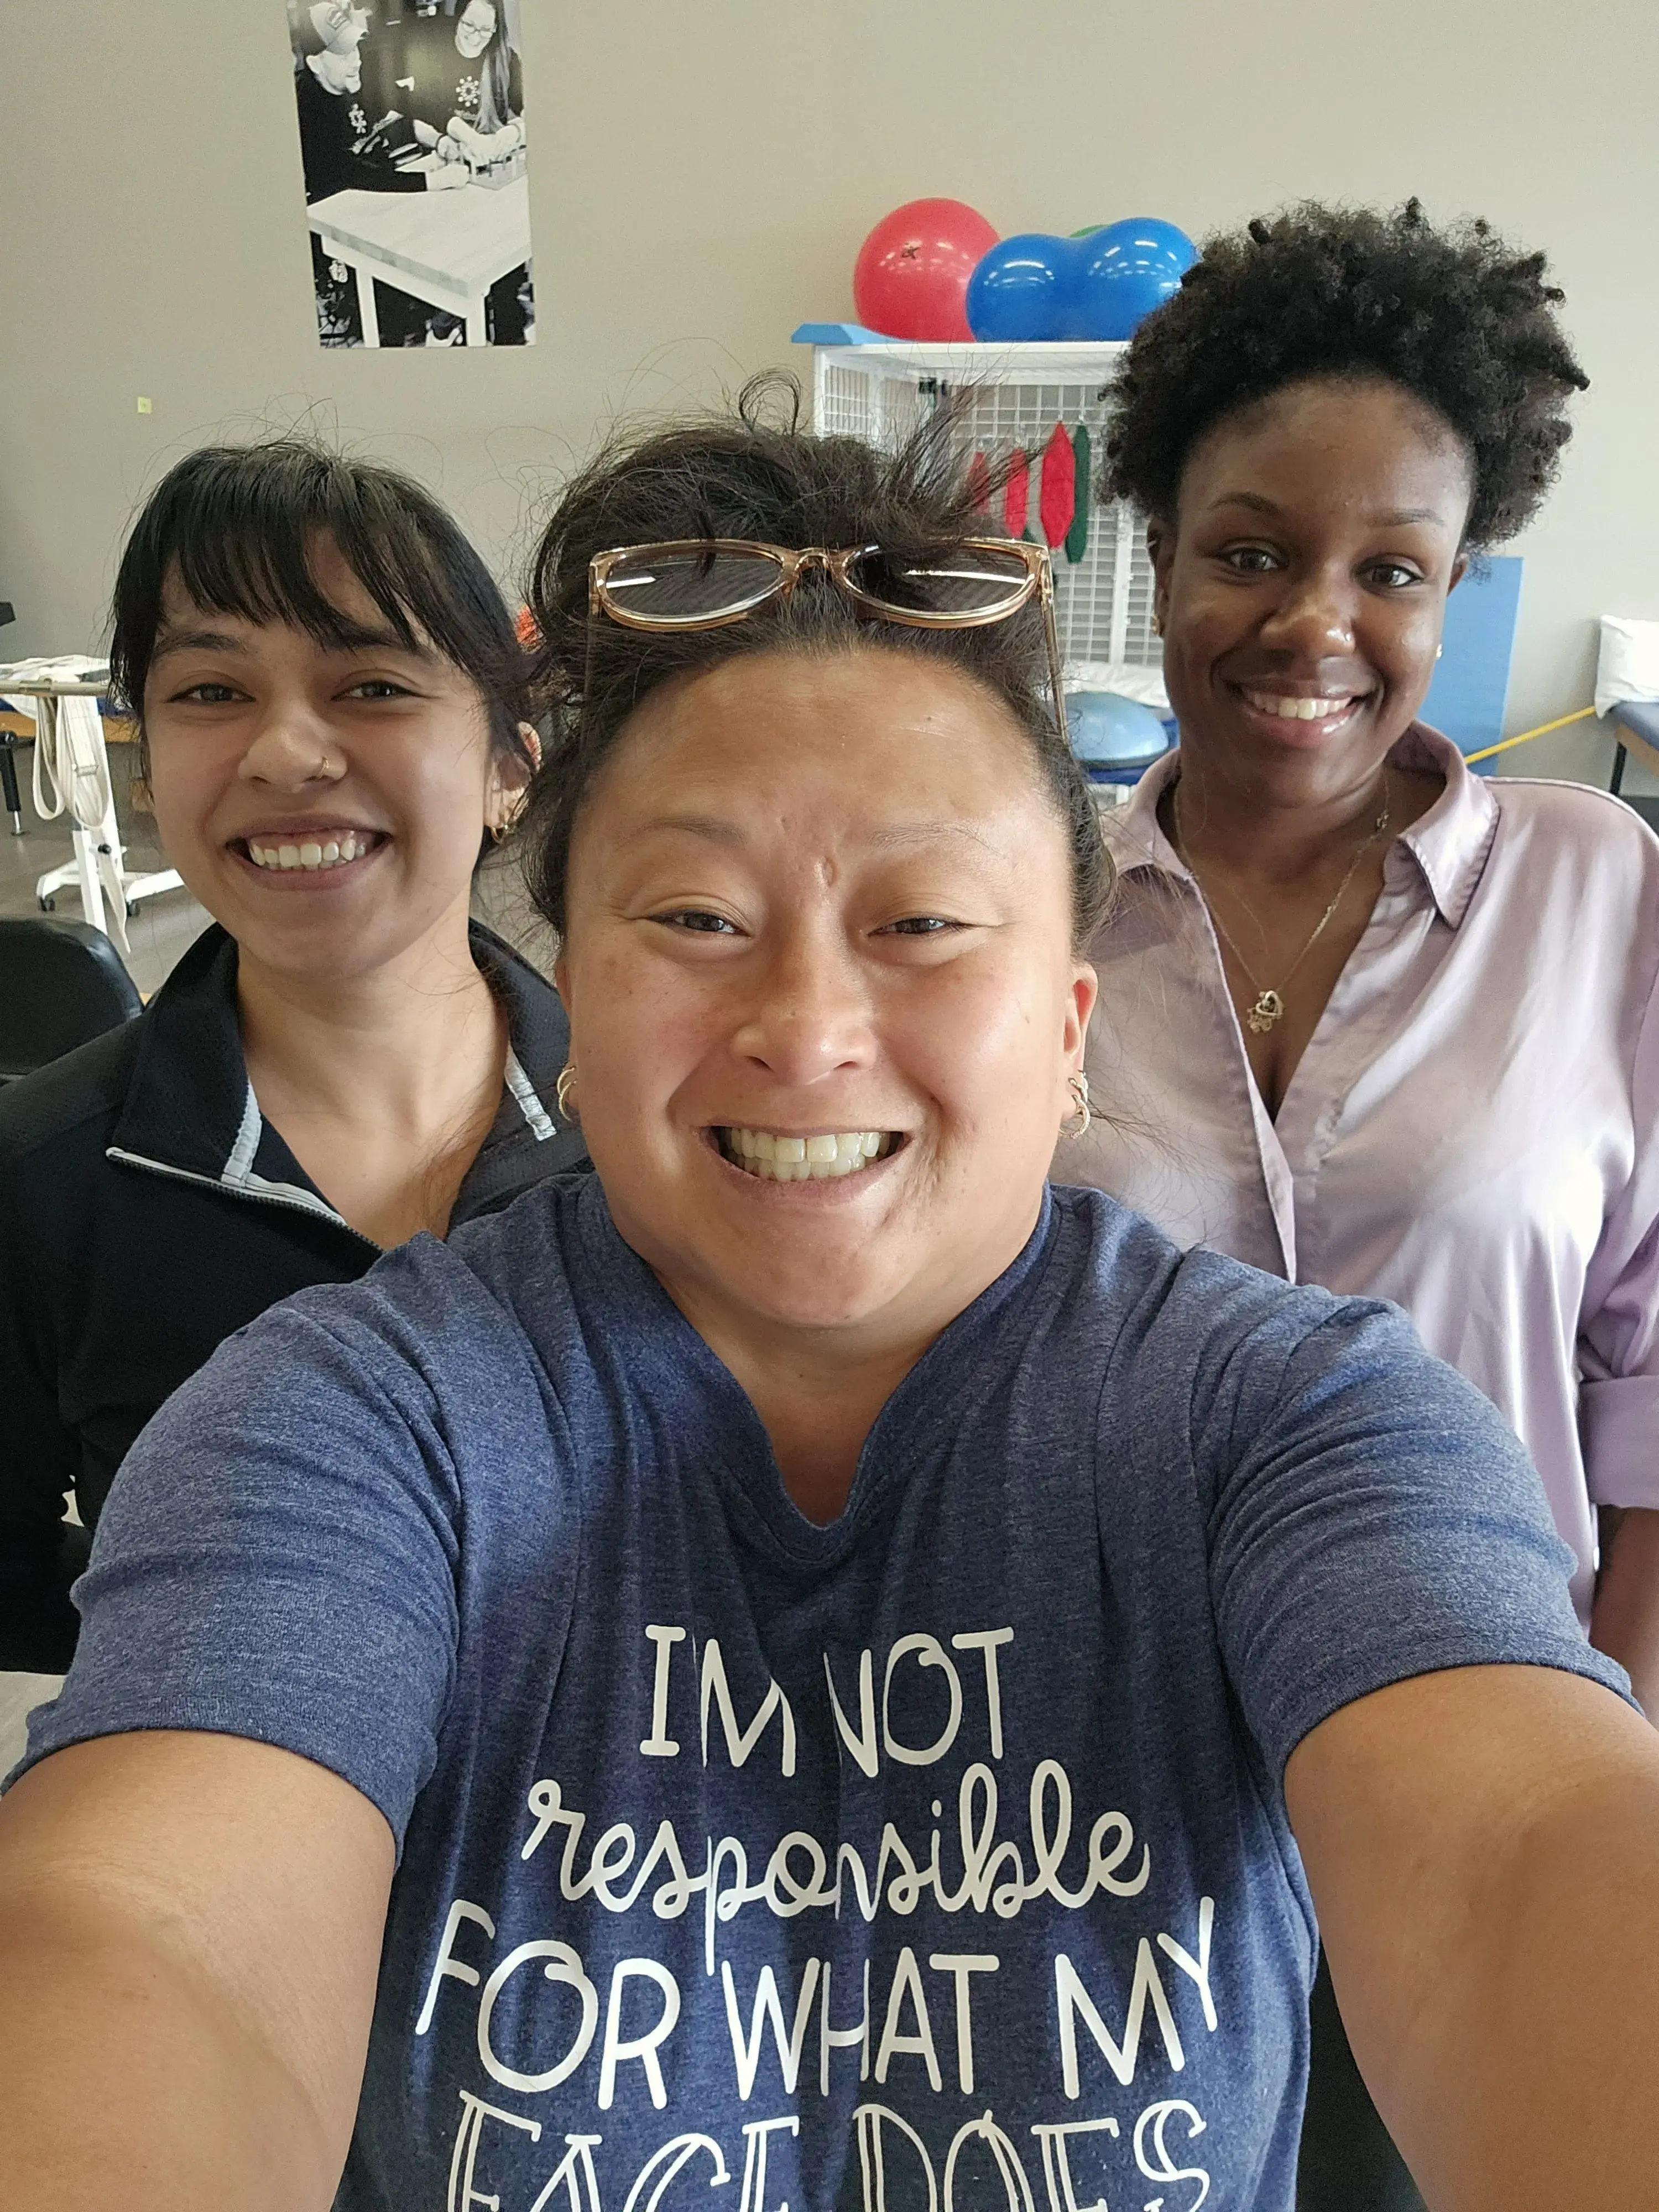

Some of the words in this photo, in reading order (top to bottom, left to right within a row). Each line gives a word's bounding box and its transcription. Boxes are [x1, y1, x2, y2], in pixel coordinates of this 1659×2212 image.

[823, 1626, 1014, 1778] NOT
[521, 1759, 1149, 1976] responsible
[415, 1899, 680, 2110] FOR
[722, 1947, 1000, 2099] WHAT
[1055, 1897, 1218, 2098] MY
